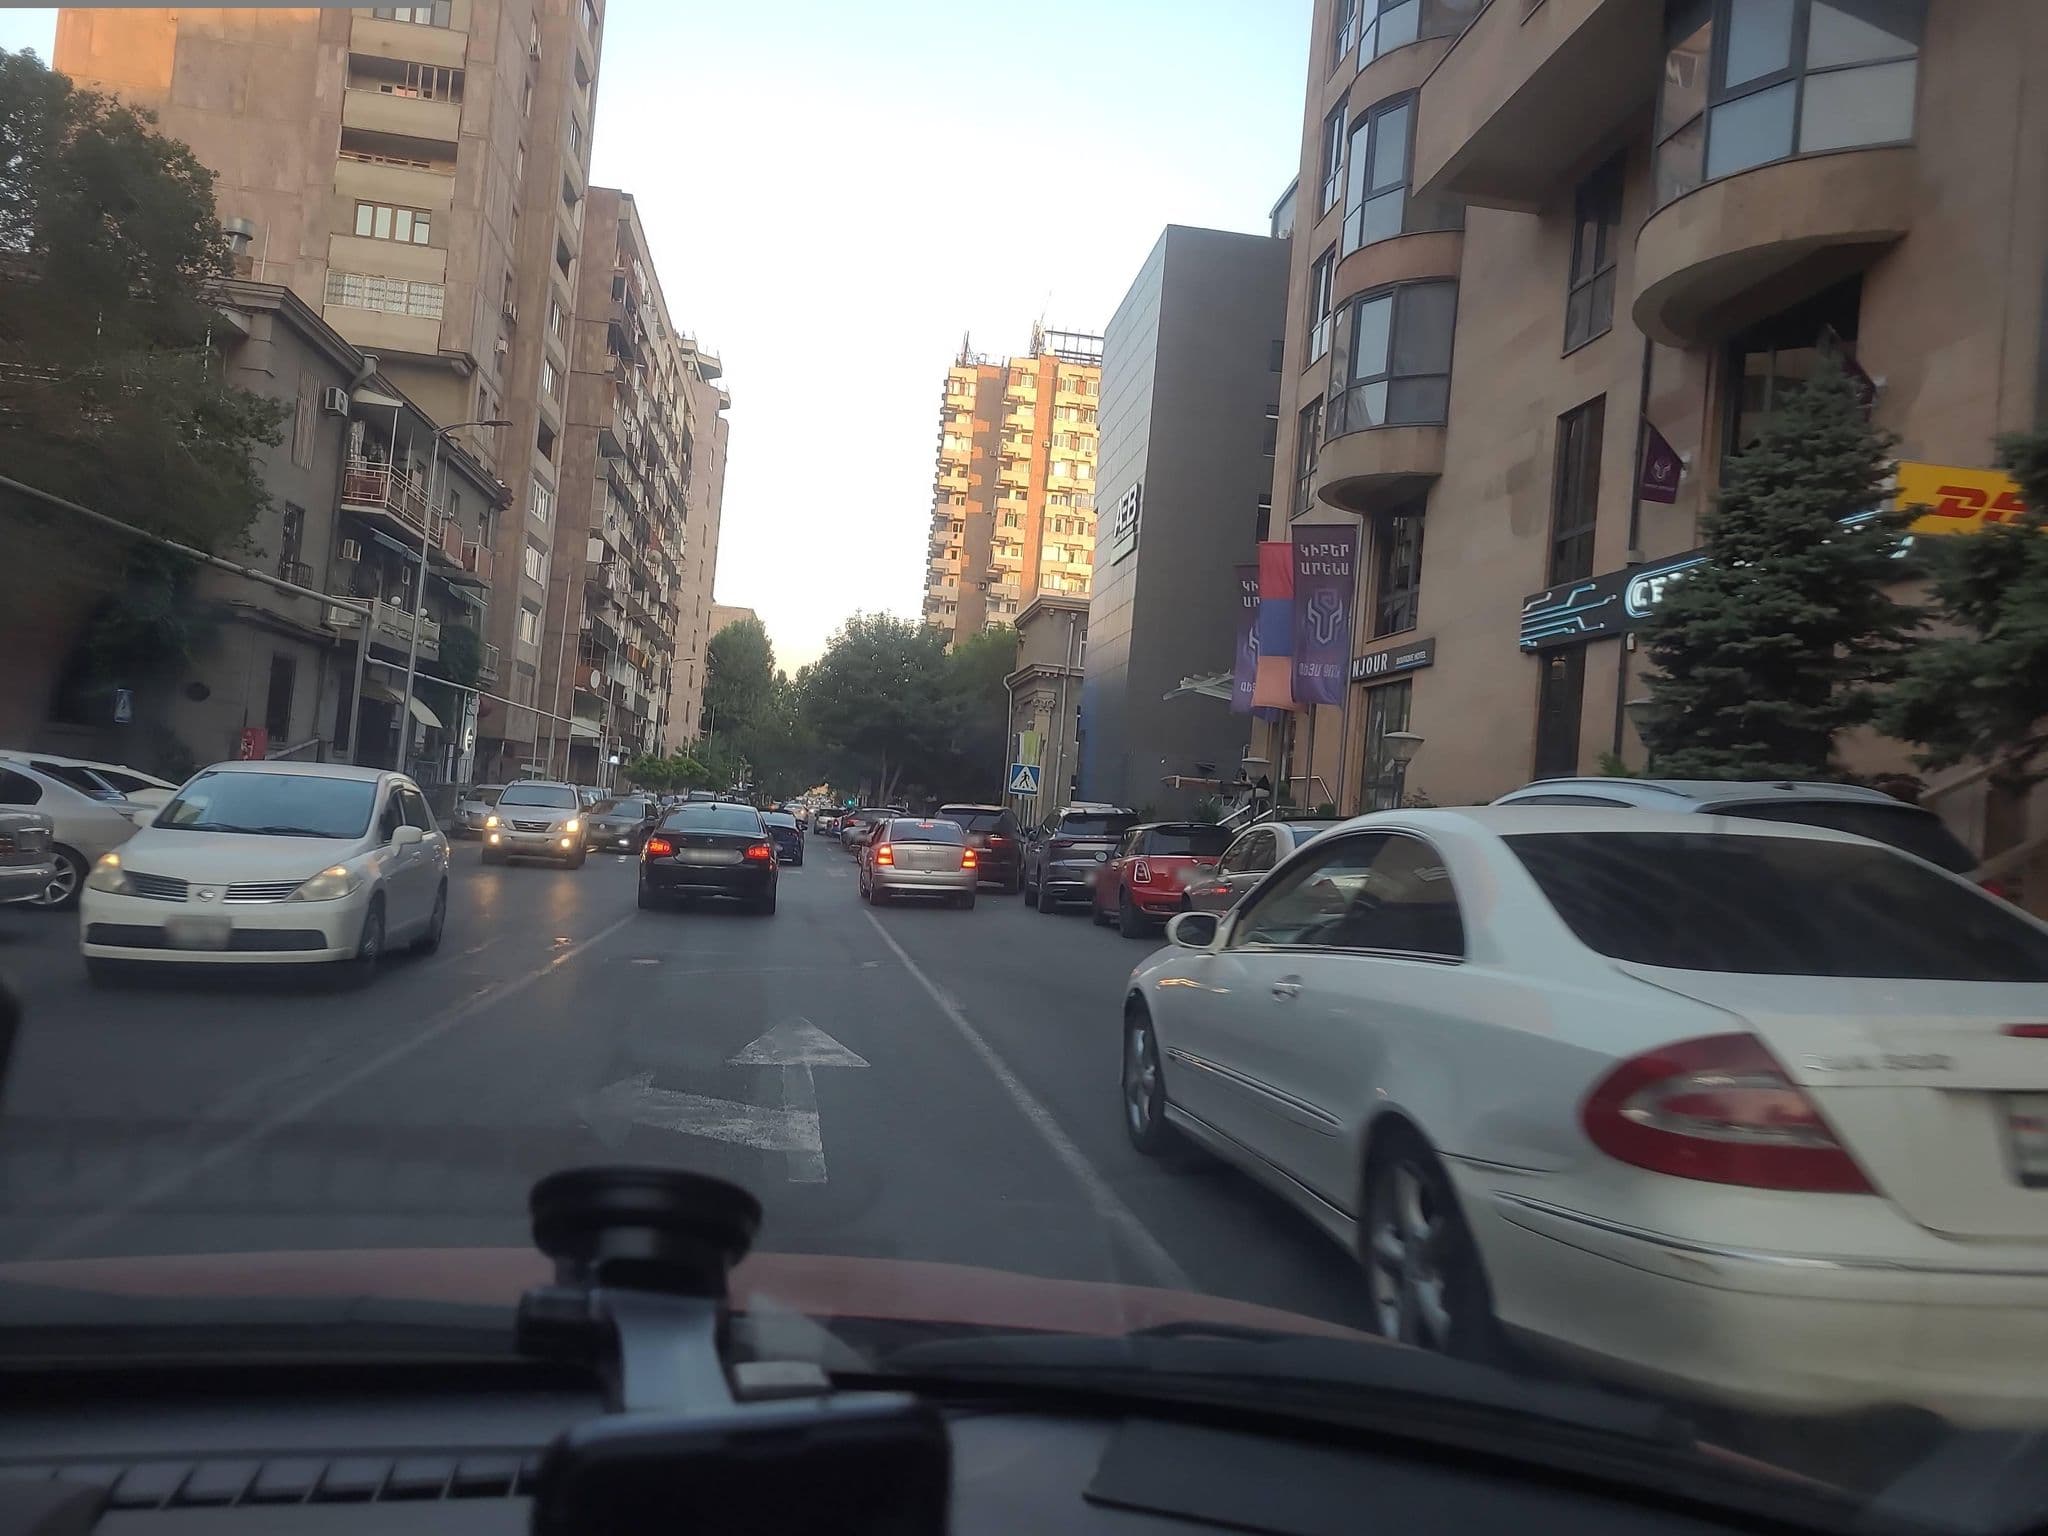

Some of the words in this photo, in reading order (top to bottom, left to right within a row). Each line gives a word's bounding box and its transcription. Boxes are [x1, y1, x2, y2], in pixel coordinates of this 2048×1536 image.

[1113, 482, 1138, 538] AEB
[1934, 485, 2030, 524] DH
[1300, 543, 1349, 557] ԿԻԲԵՐ
[1242, 580, 1259, 592] ԿԻ
[1243, 596, 1261, 608] ԱՐ
[1351, 652, 1388, 678] NJOUR
